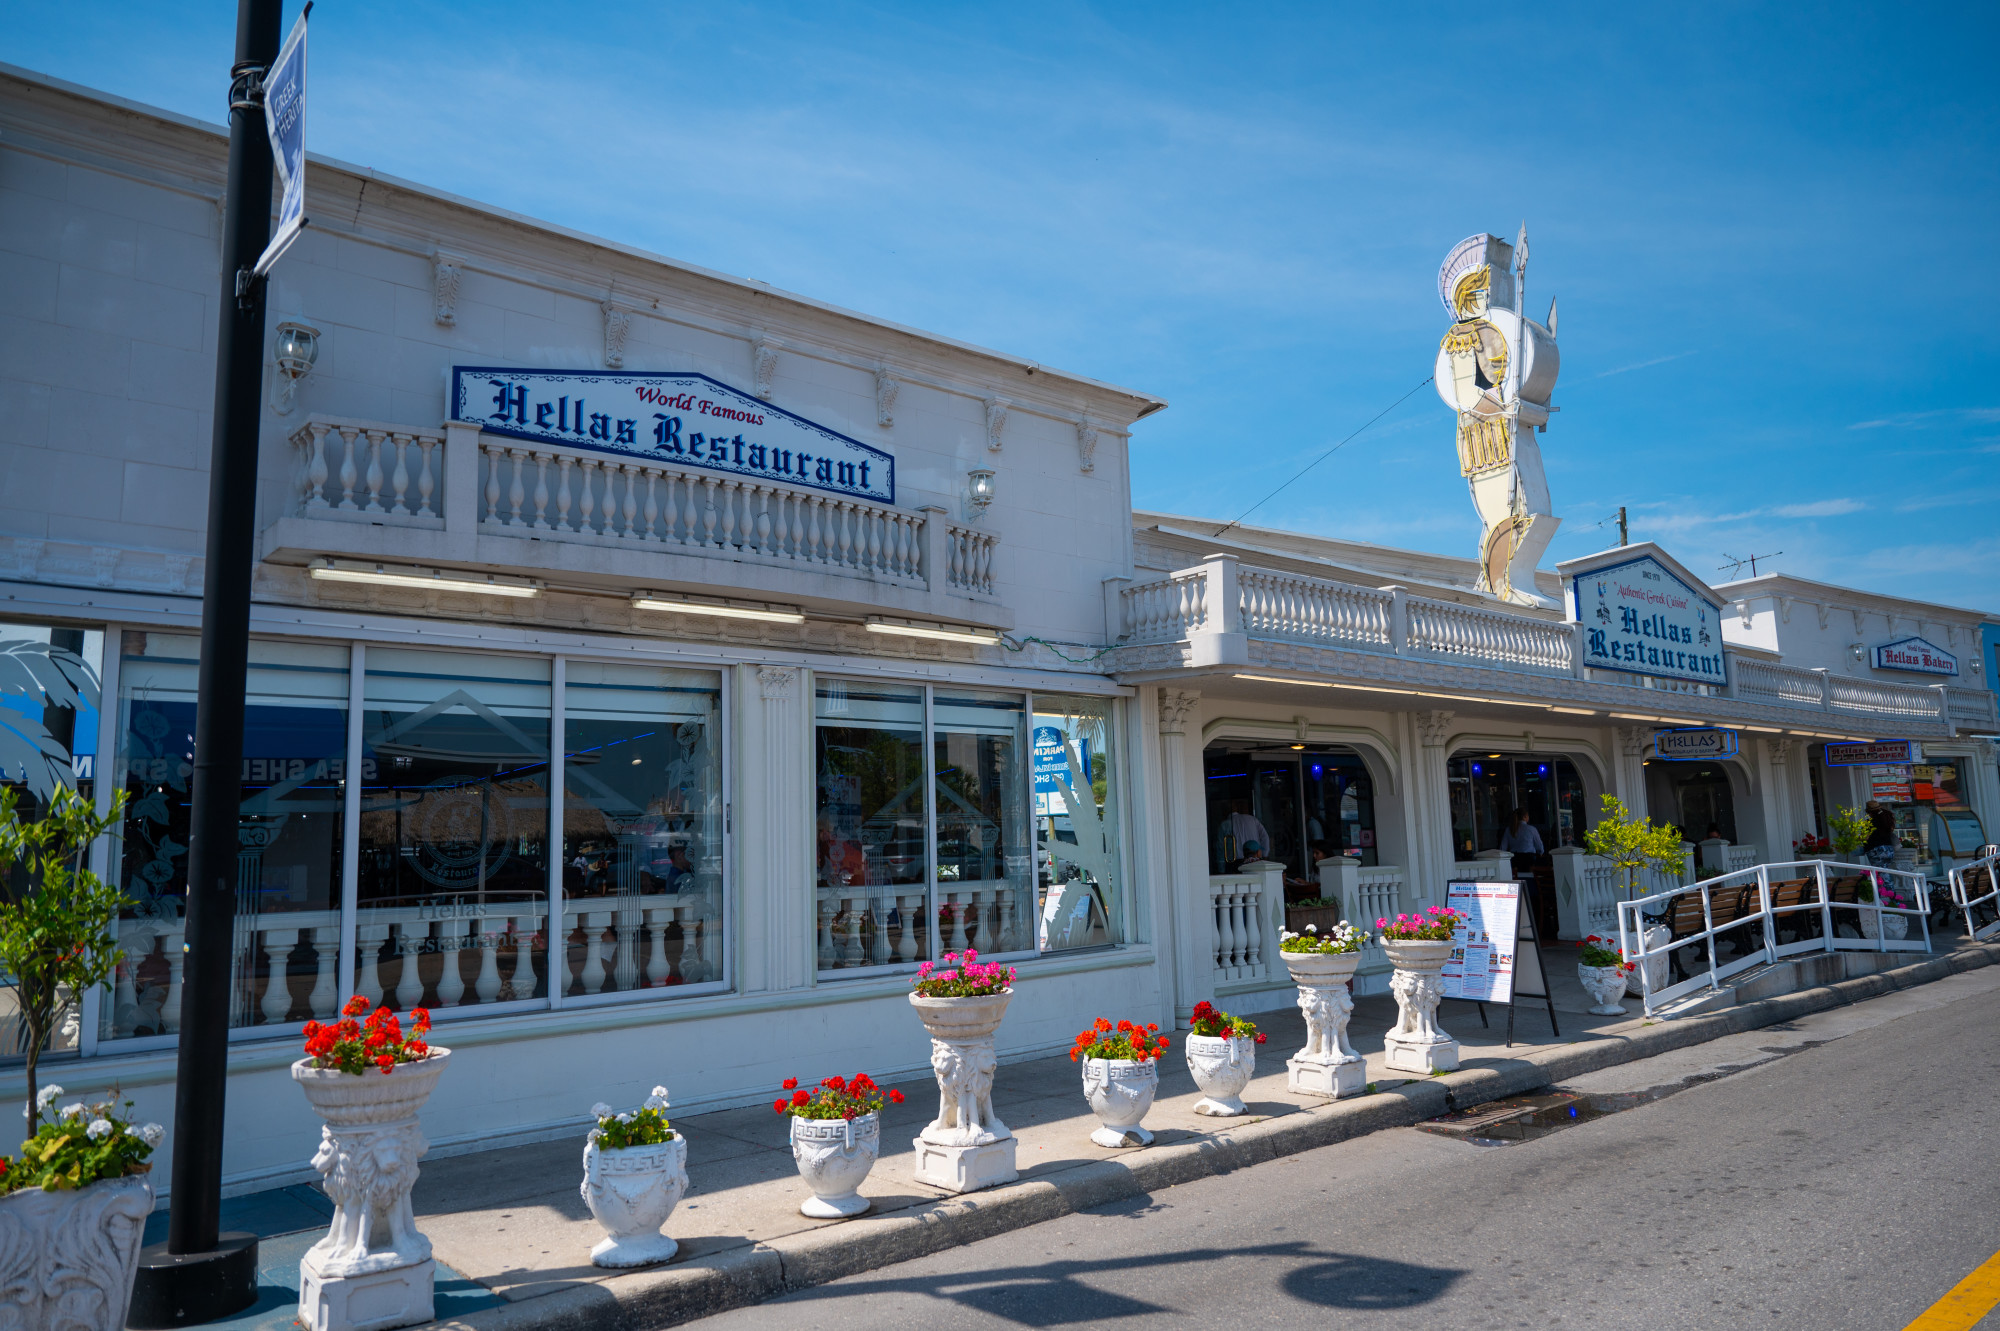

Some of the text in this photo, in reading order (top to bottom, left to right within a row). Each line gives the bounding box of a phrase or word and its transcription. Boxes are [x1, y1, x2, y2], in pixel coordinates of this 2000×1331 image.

[275, 76, 297, 117] GREEK
[277, 93, 303, 139] HERITA
[635, 386, 765, 426] World Famous
[489, 380, 872, 490] Hellas Restaurant
[1646, 589, 1666, 605] Greek
[1618, 605, 1692, 644] Hellas
[1587, 627, 1722, 675] Restaurant
[1885, 649, 1953, 671] Hellas Bakery
[1668, 734, 1715, 747] HELLAS
[1832, 745, 1906, 755] Hellas Bakery
[416, 896, 487, 920] Hellas
[393, 932, 518, 955] Restaurant
